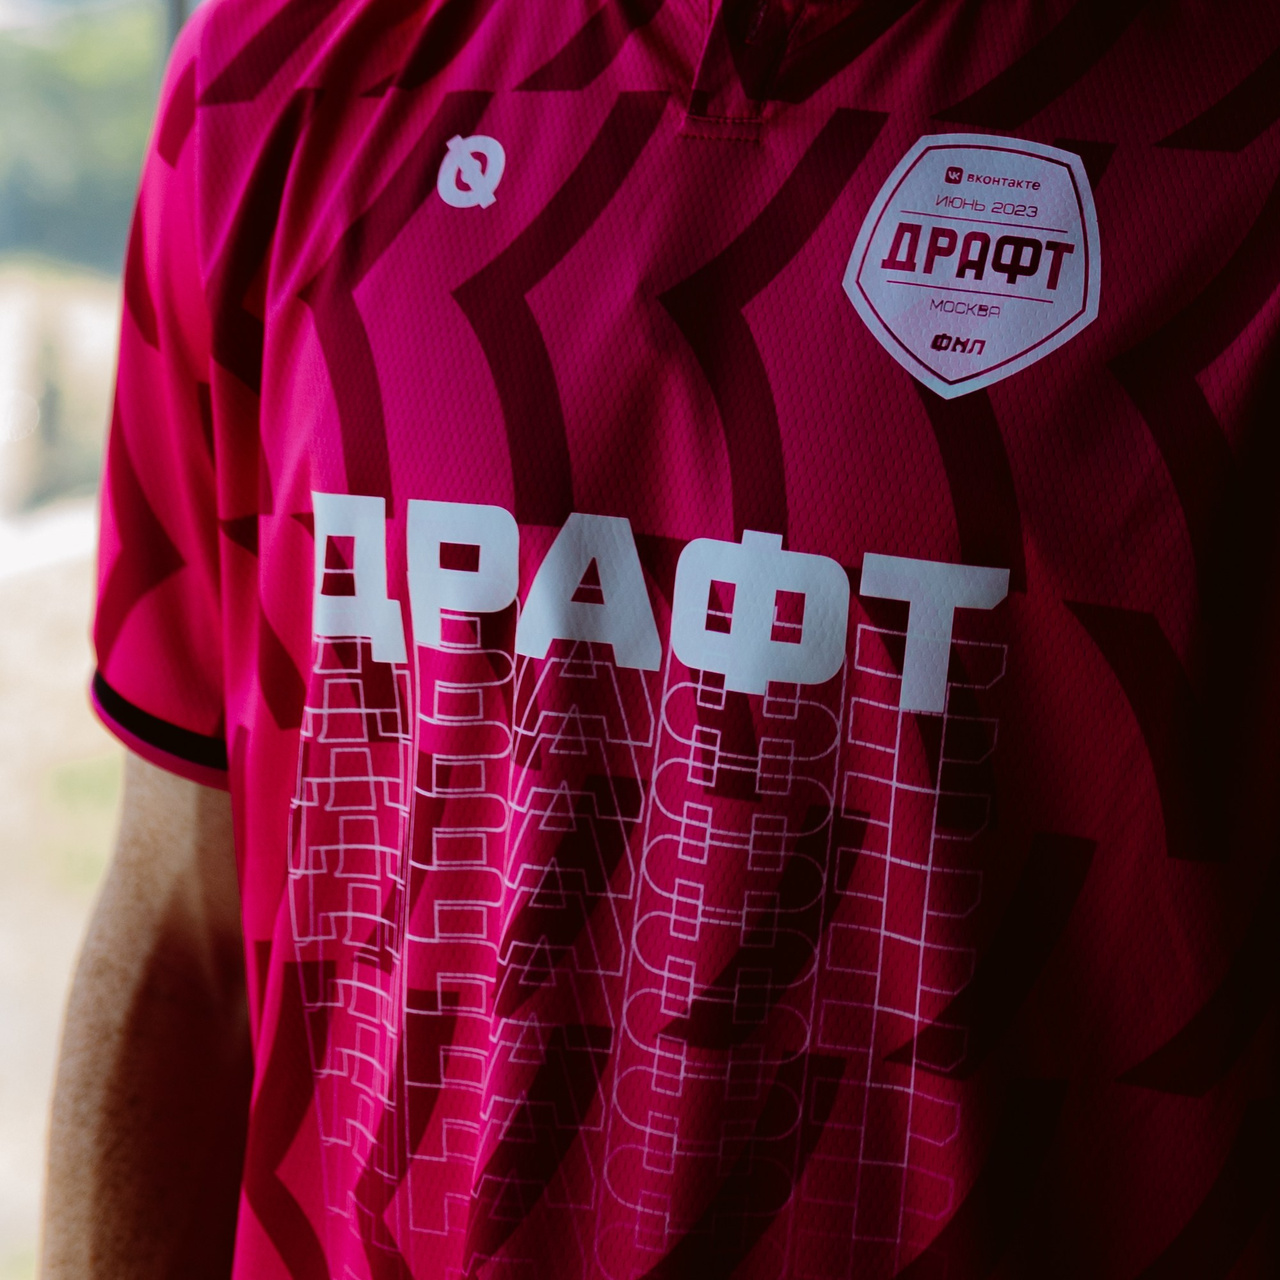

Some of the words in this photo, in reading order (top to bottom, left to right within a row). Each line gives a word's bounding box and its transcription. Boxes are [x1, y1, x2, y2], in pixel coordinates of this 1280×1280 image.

[936, 194, 986, 212] ИЮНЬ
[991, 201, 1038, 218] 2023
[881, 222, 1075, 291] ДРАФТ
[930, 299, 1001, 319] МОСКВА
[311, 491, 1010, 712] ДРАФТ
